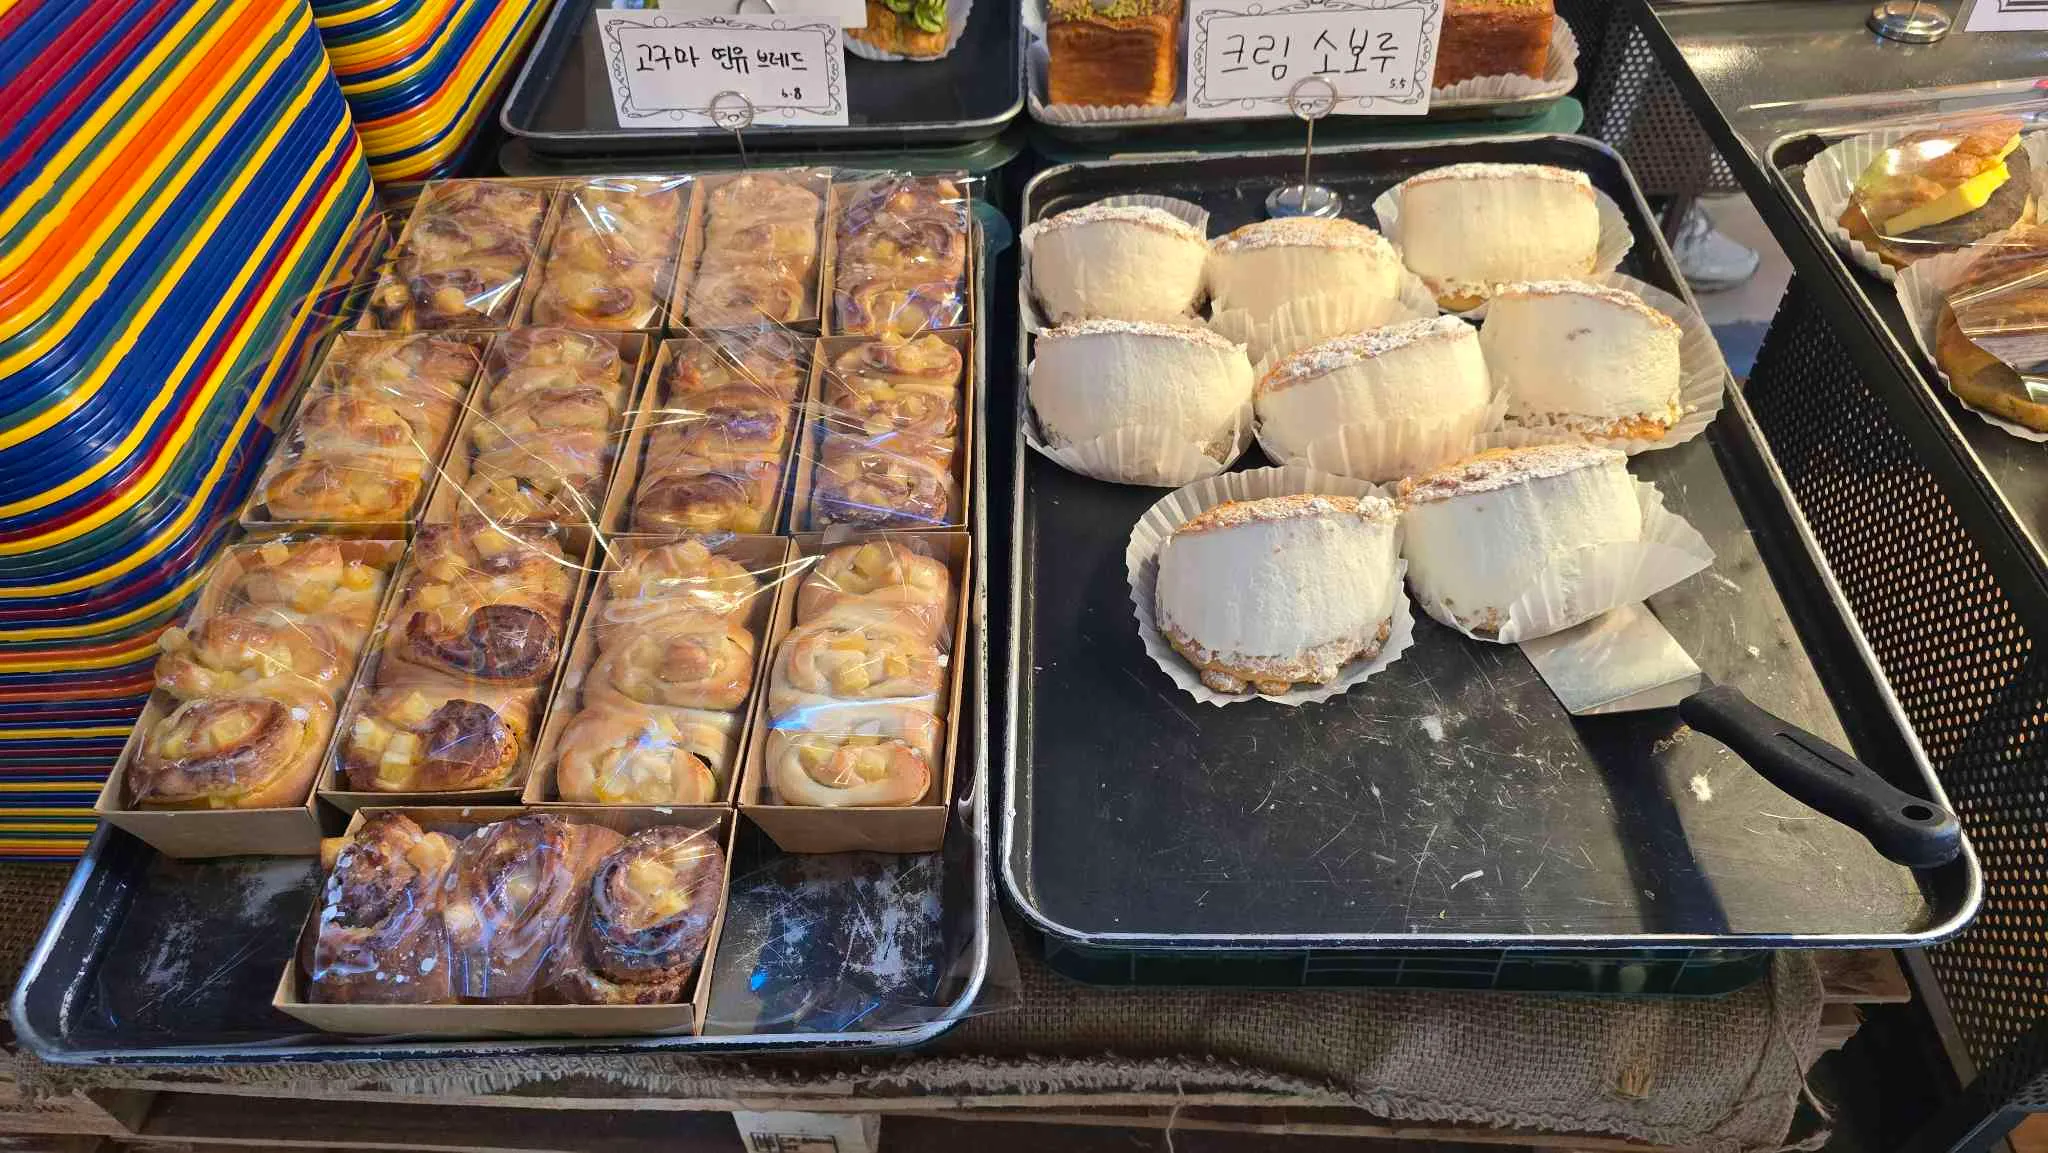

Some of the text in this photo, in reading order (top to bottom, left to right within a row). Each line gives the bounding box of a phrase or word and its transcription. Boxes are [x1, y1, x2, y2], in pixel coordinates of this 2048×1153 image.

[636, 43, 808, 75] 고구마 연유 브레드
[1220, 28, 1399, 81] 크림 소보루
[781, 87, 803, 100] 6.8
[1389, 77, 1407, 89] 5.5
